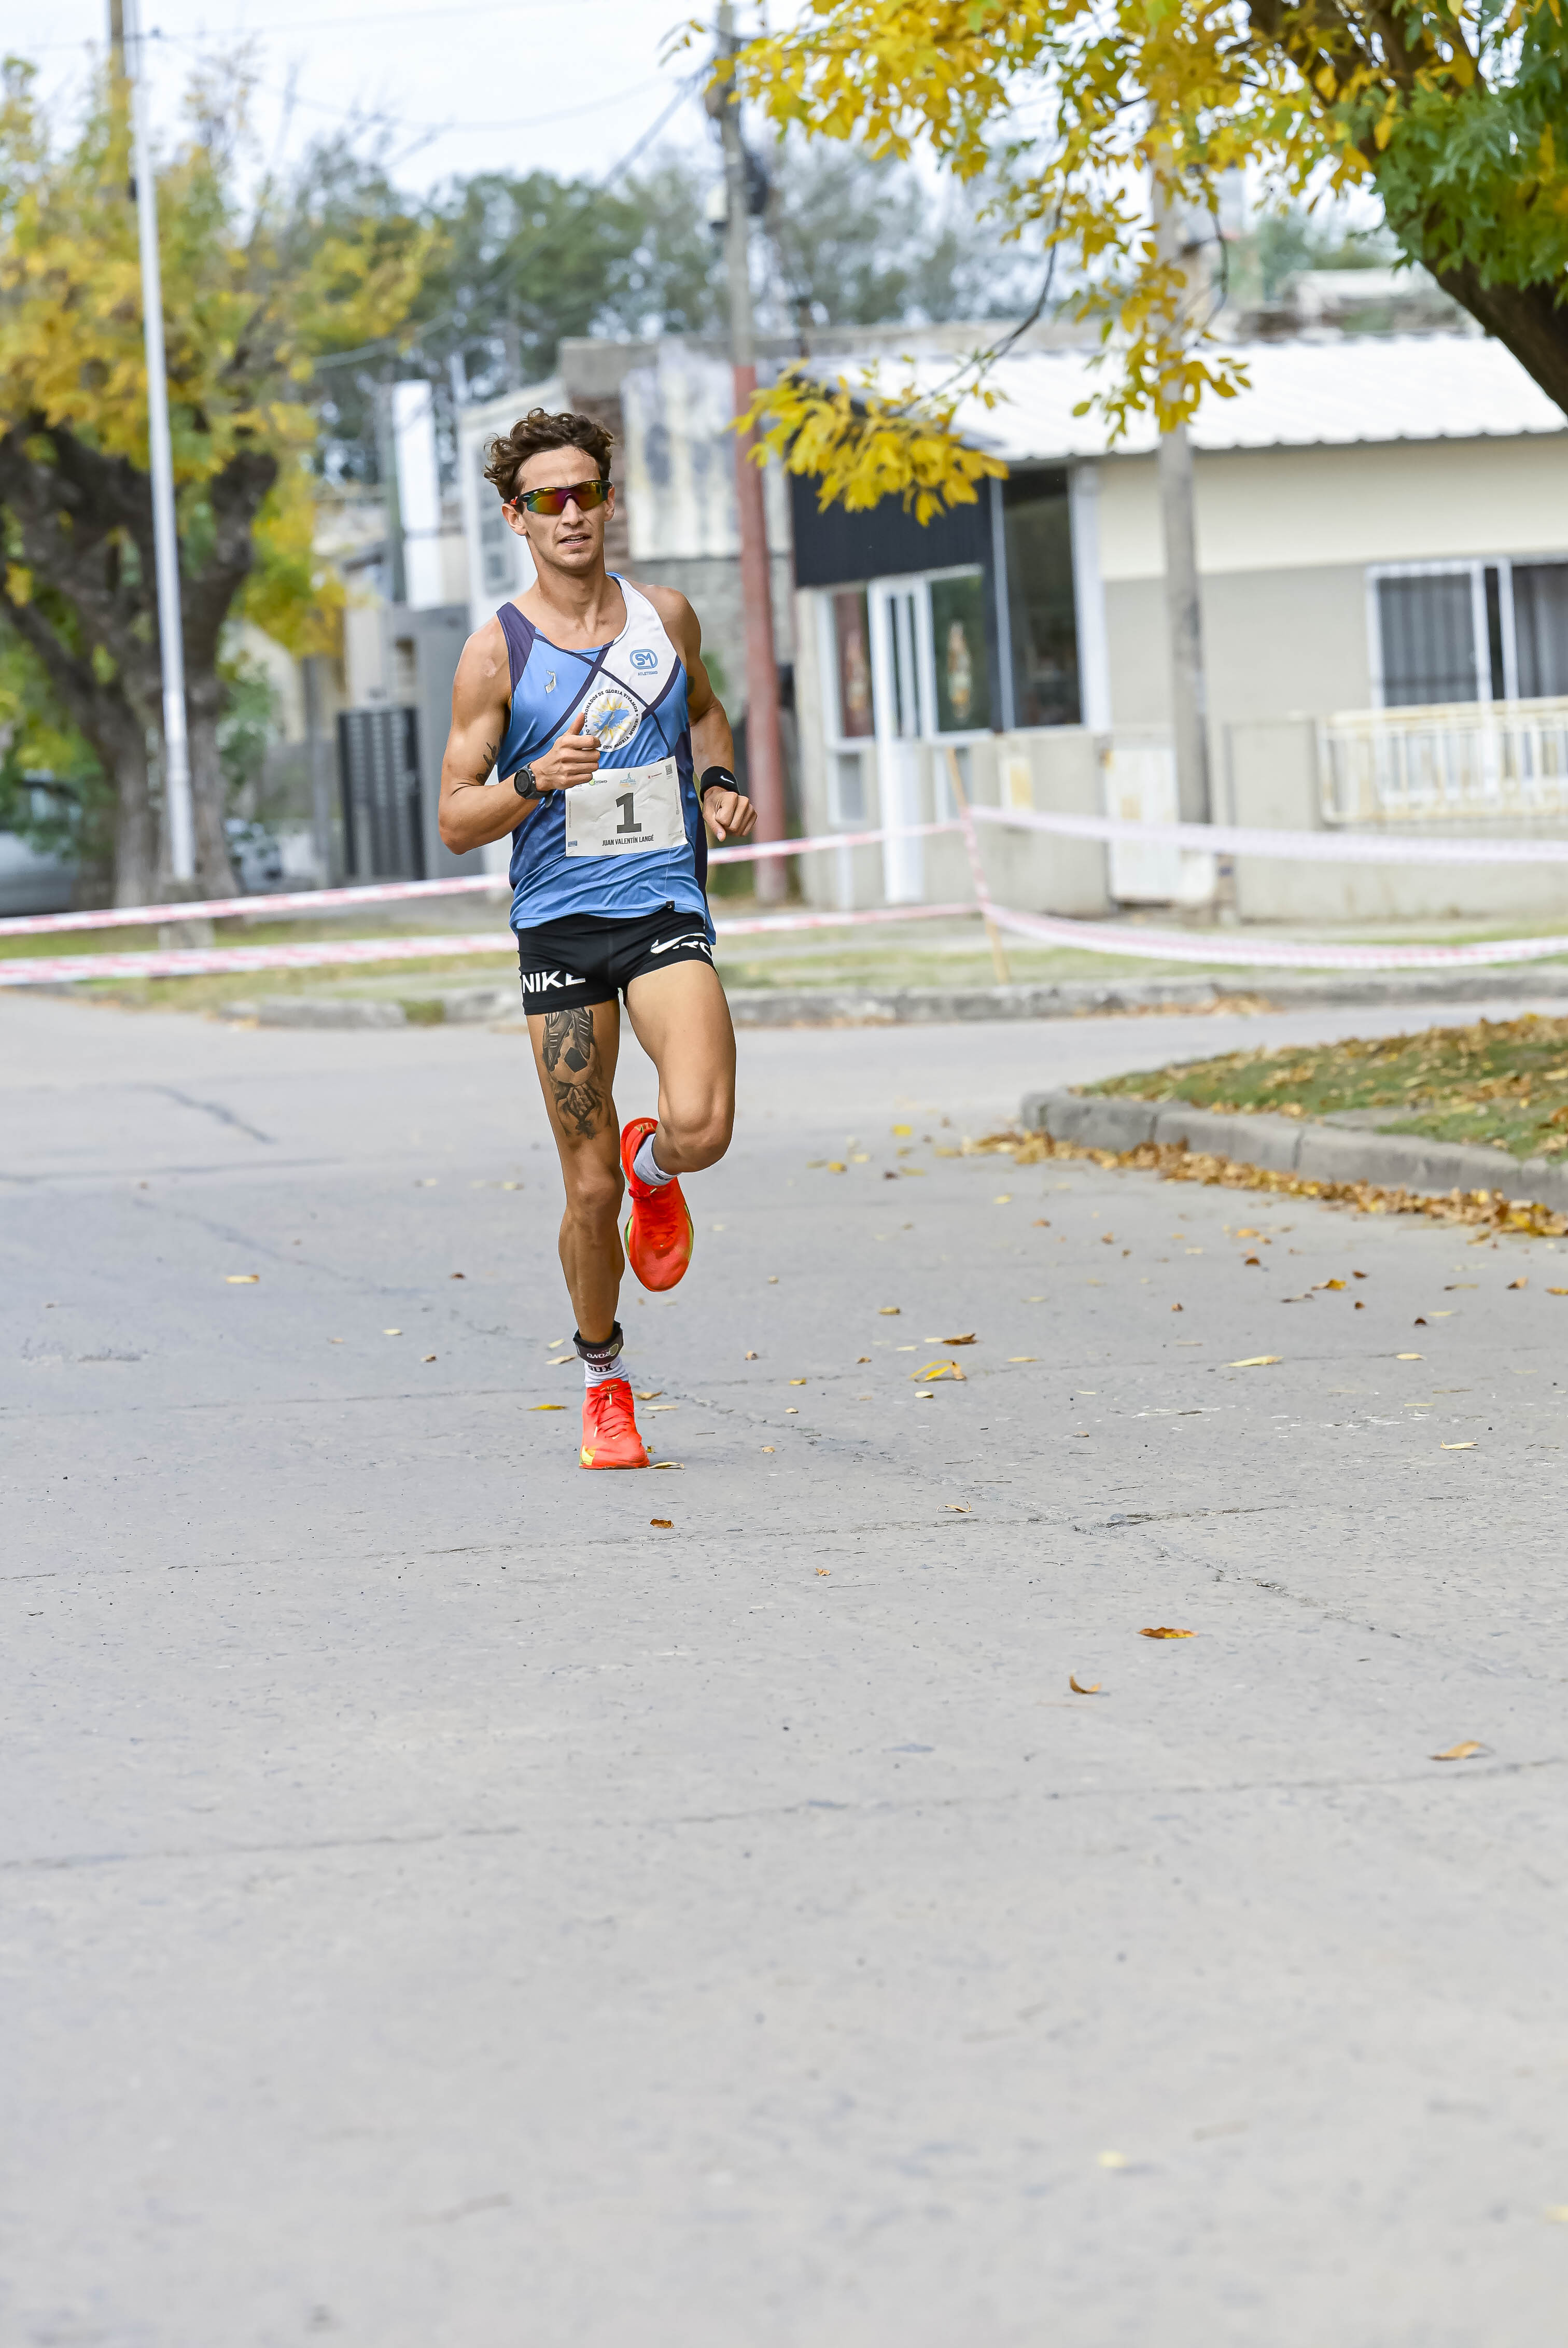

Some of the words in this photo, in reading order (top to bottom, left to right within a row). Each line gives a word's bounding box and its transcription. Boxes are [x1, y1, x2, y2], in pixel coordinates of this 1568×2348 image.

[635, 653, 653, 668] SM
[623, 693, 638, 712] VIVAMOS
[615, 792, 642, 833] 1
[615, 836, 638, 845] VALENTÍN
[639, 834, 654, 842] LANGÉ
